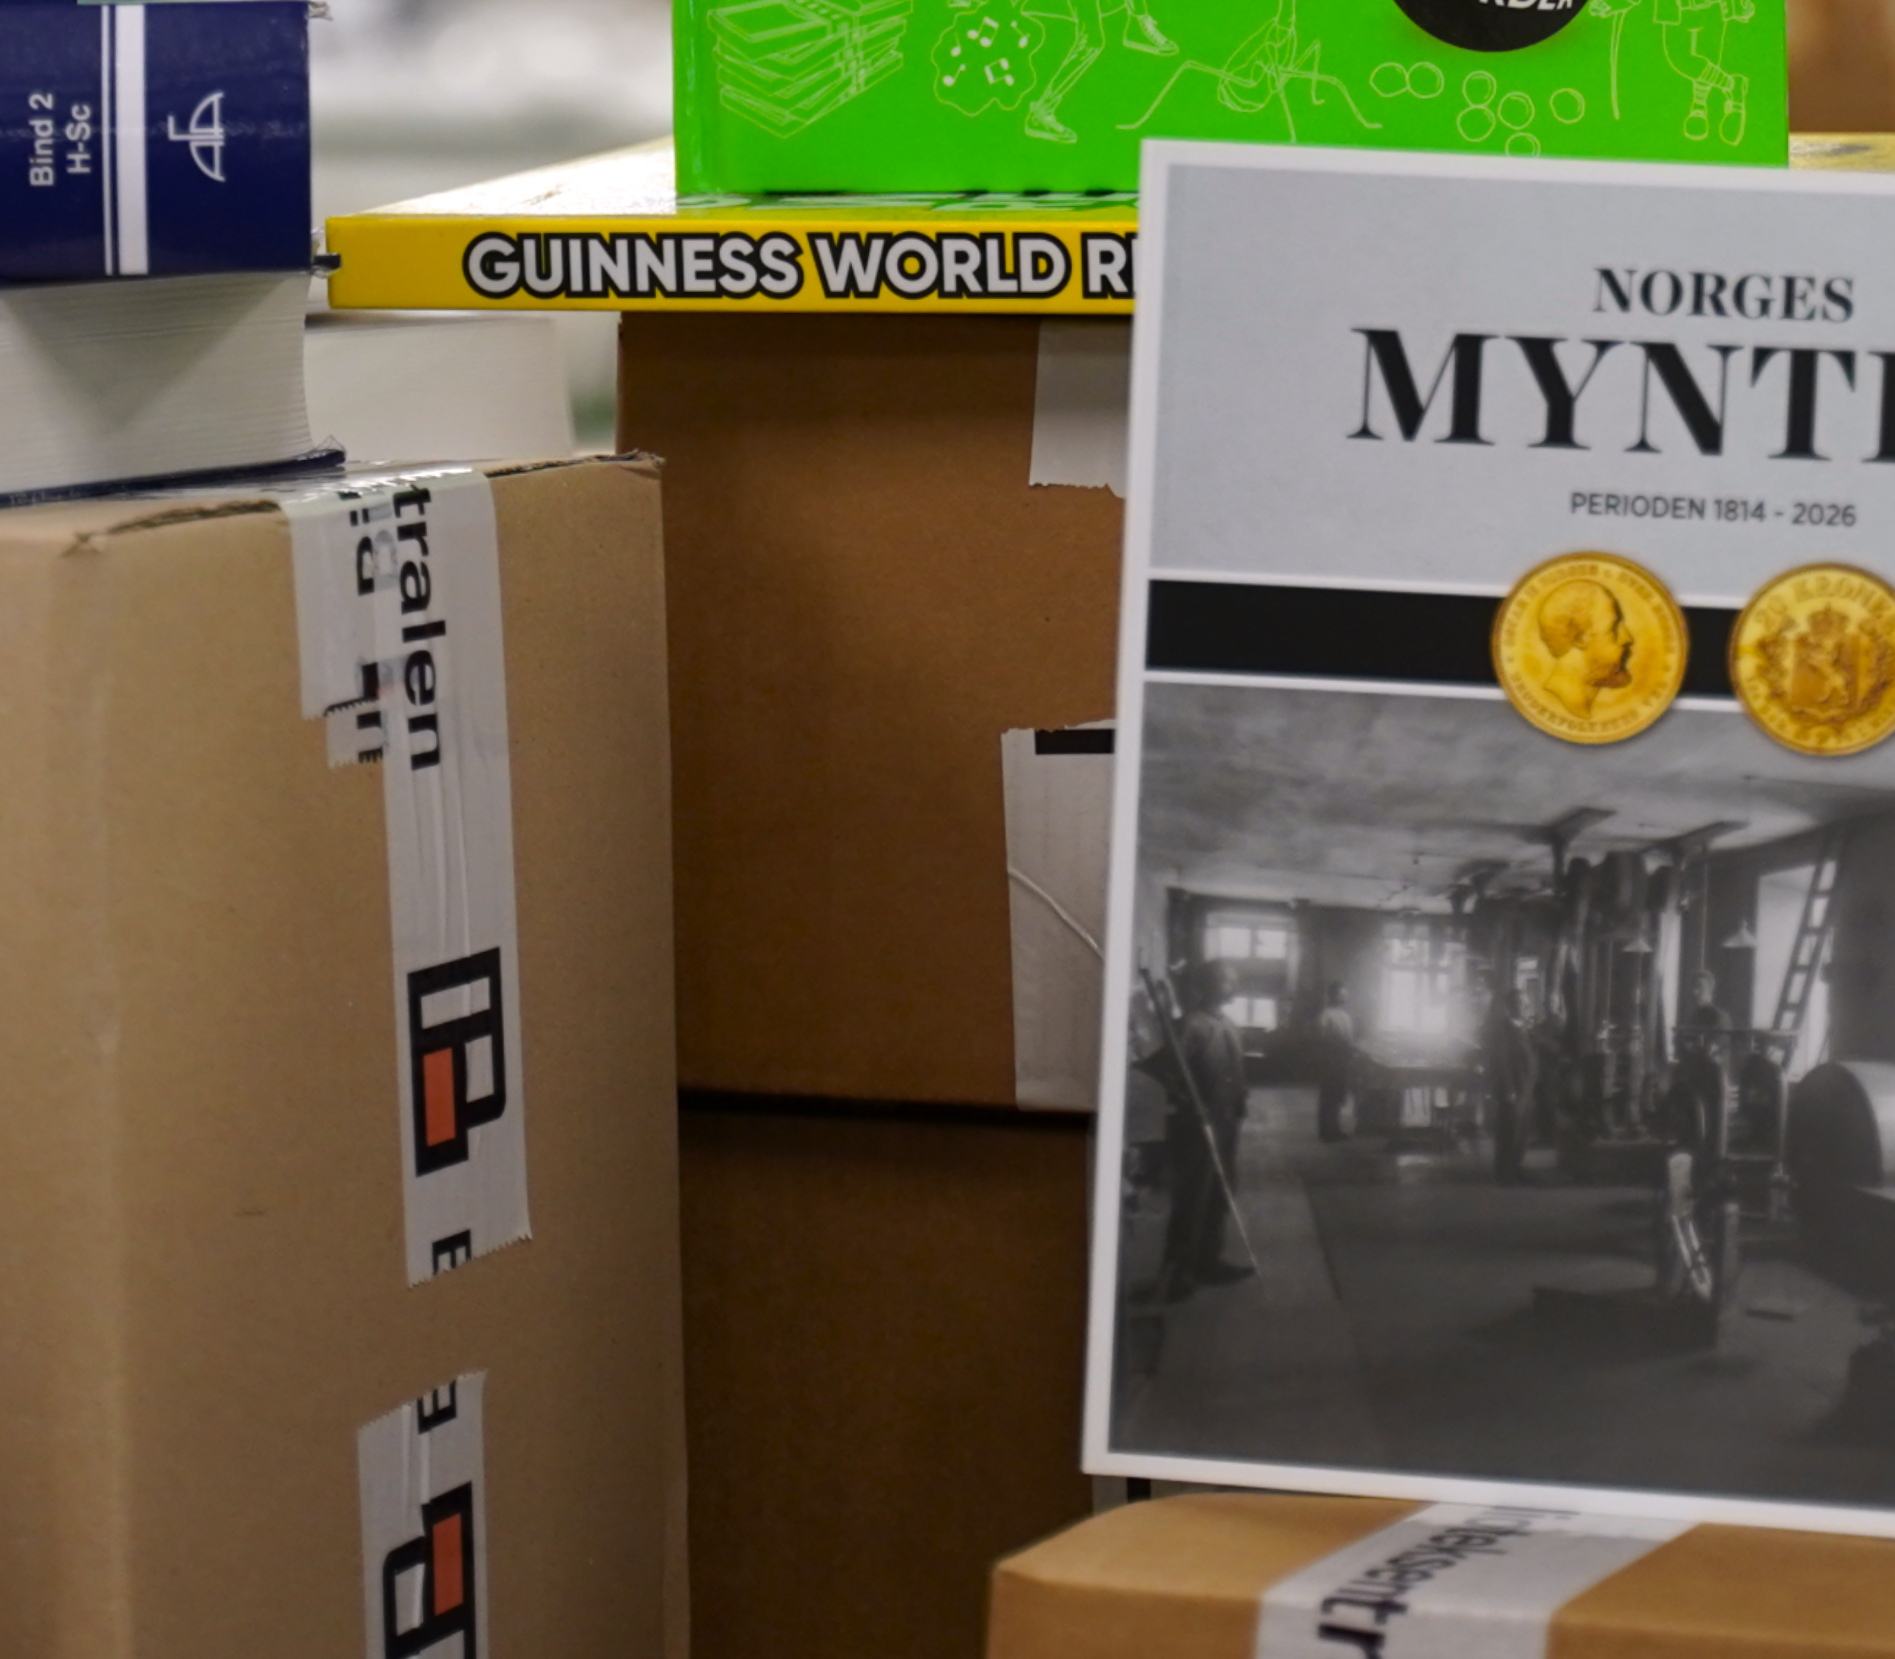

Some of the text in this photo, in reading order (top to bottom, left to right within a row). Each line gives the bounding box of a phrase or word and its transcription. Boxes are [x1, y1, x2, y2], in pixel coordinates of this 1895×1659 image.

[28, 93, 54, 187] Bind 2
[64, 103, 92, 175] H-Sc
[464, 232, 804, 301] GUINNESS
[808, 231, 1072, 301] WORLD
[1592, 267, 1856, 324] NORGES
[1571, 491, 1706, 521] PERIODEN
[1714, 497, 1767, 523] 1814
[1792, 502, 1857, 528] 2026
